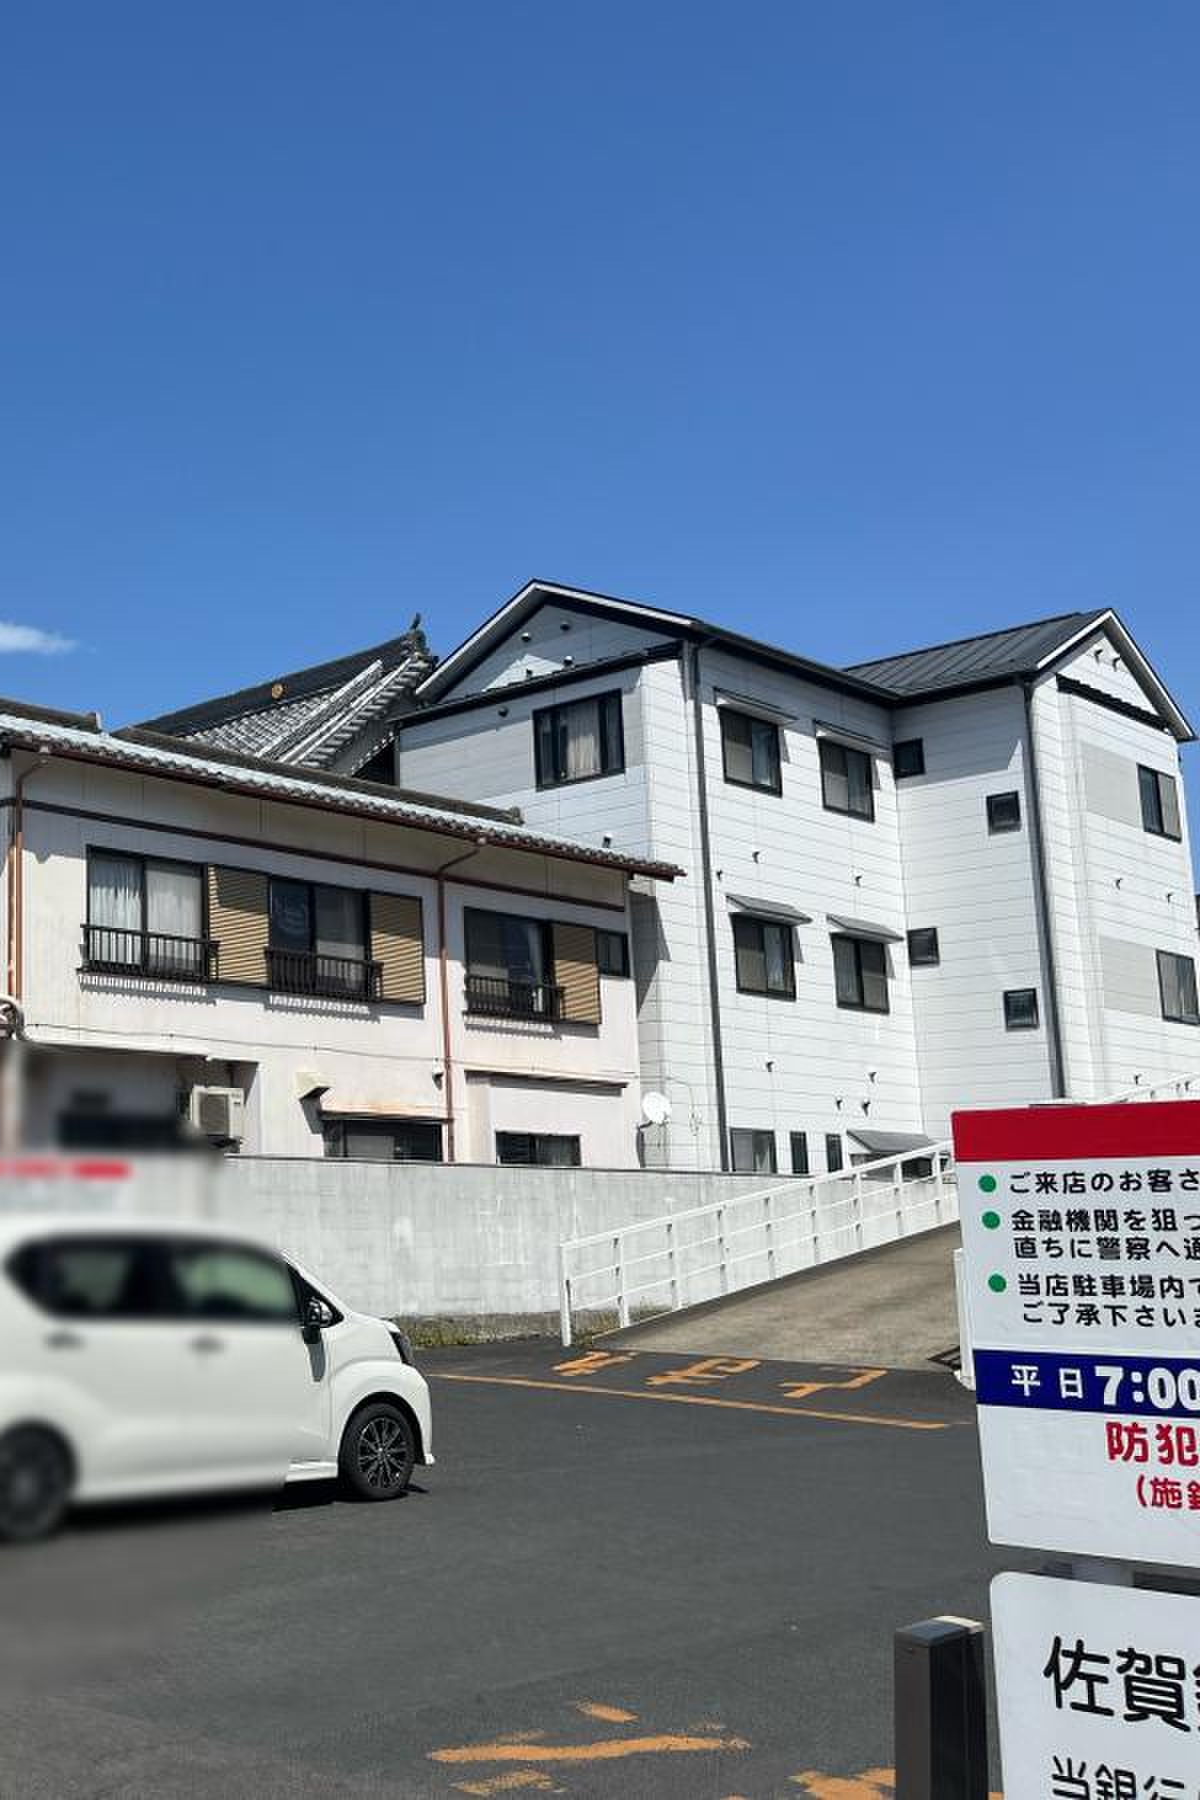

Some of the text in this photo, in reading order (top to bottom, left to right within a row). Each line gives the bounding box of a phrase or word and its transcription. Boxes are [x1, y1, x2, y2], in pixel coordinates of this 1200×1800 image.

[1009, 1168, 1200, 1194] ご来店のお客さ
[1013, 1236, 1200, 1260] 直ちに警察へ通
[1023, 1301, 1200, 1328] ご了承下さい
[1106, 1421, 1199, 1467] 防犯
[1043, 1635, 1200, 1732] 佐賀
